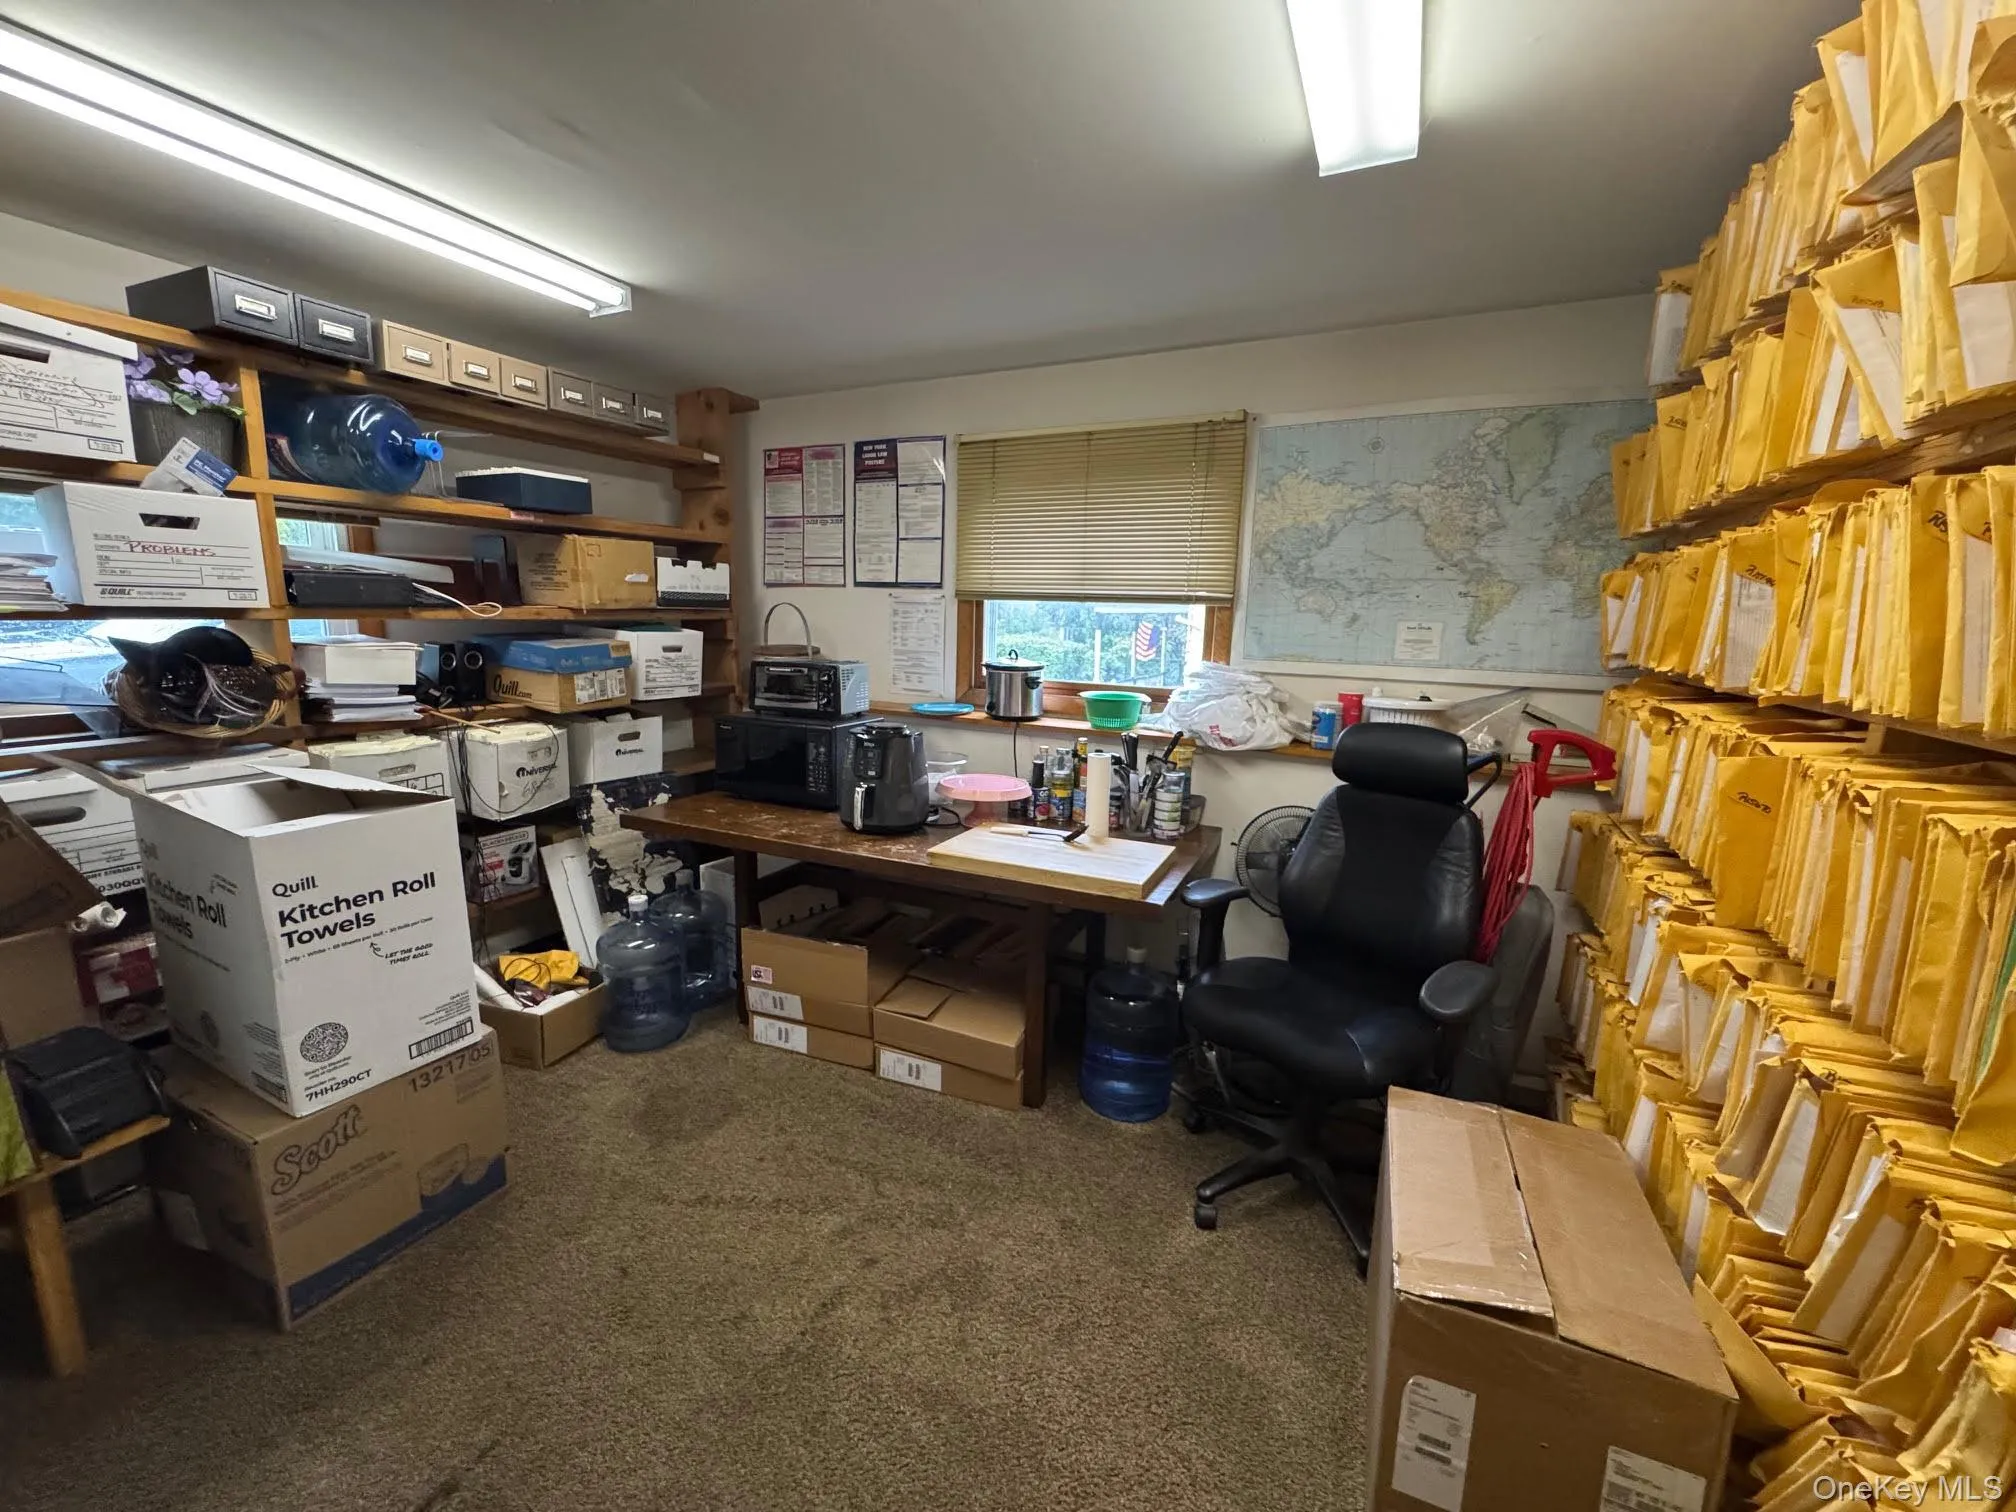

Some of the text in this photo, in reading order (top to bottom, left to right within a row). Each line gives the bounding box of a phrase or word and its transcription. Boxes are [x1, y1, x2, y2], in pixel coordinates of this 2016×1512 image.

[124, 540, 216, 557] PROBLEMS
[493, 674, 532, 699] Quill.com
[272, 876, 318, 898] Quill
[279, 872, 436, 928] Kitchen Roll
[196, 895, 228, 928] Roll
[280, 912, 376, 949] Towels
[385, 950, 399, 959] LET
[400, 947, 413, 955] THE
[305, 1068, 372, 1102] 7HH290CT
[271, 1103, 362, 1196] Scott
